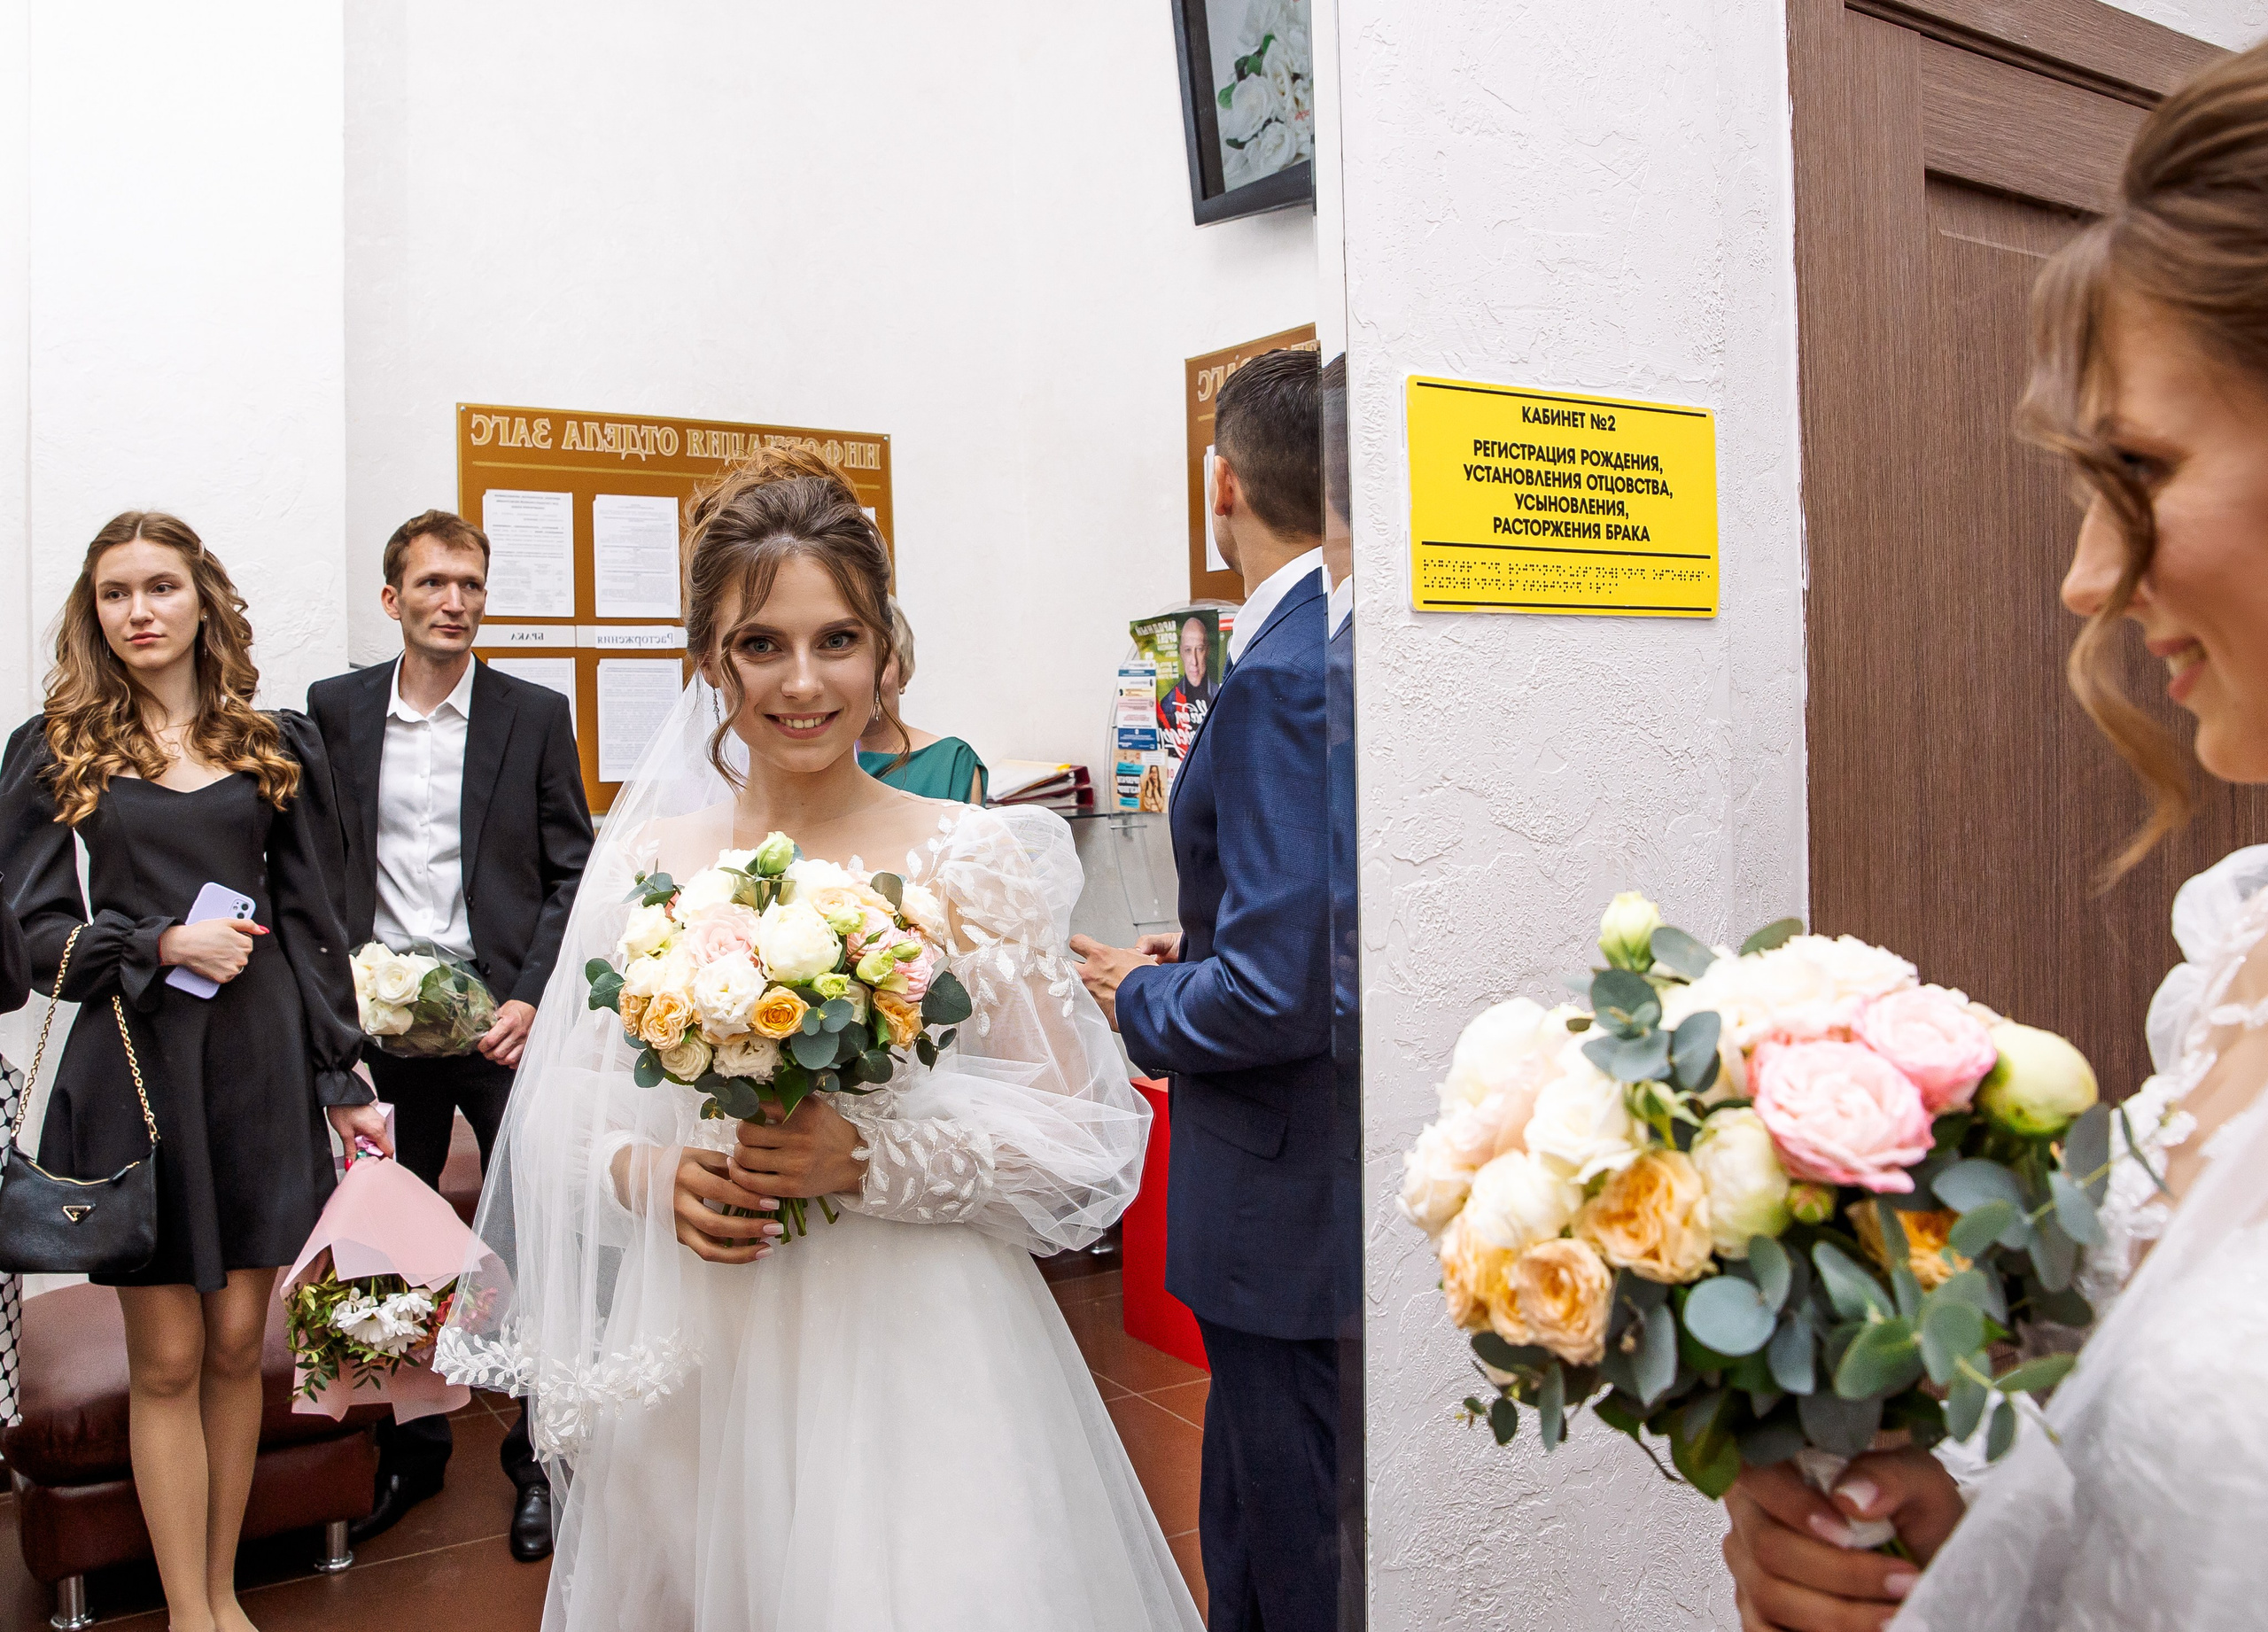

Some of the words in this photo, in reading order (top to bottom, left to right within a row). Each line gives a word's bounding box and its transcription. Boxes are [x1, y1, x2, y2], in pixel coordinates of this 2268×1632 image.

[1522, 406, 1586, 428] КАБИНЕТ
[1590, 413, 1616, 431] №2
[1473, 439, 1576, 464] РЕГИСТРАЦИЯ
[1581, 449, 1664, 474] РОЖДЕНИЯ,
[1464, 464, 1582, 490] УСТАНОВЛЕНИЯ
[1587, 474, 1674, 499] ОТЦОВСТВА,
[1514, 493, 1629, 519] УСЫНОВЛЕНИЯ,
[1493, 517, 1602, 540] РАСТОРЖЕНИЯ
[1606, 525, 1651, 541] БРАКА
